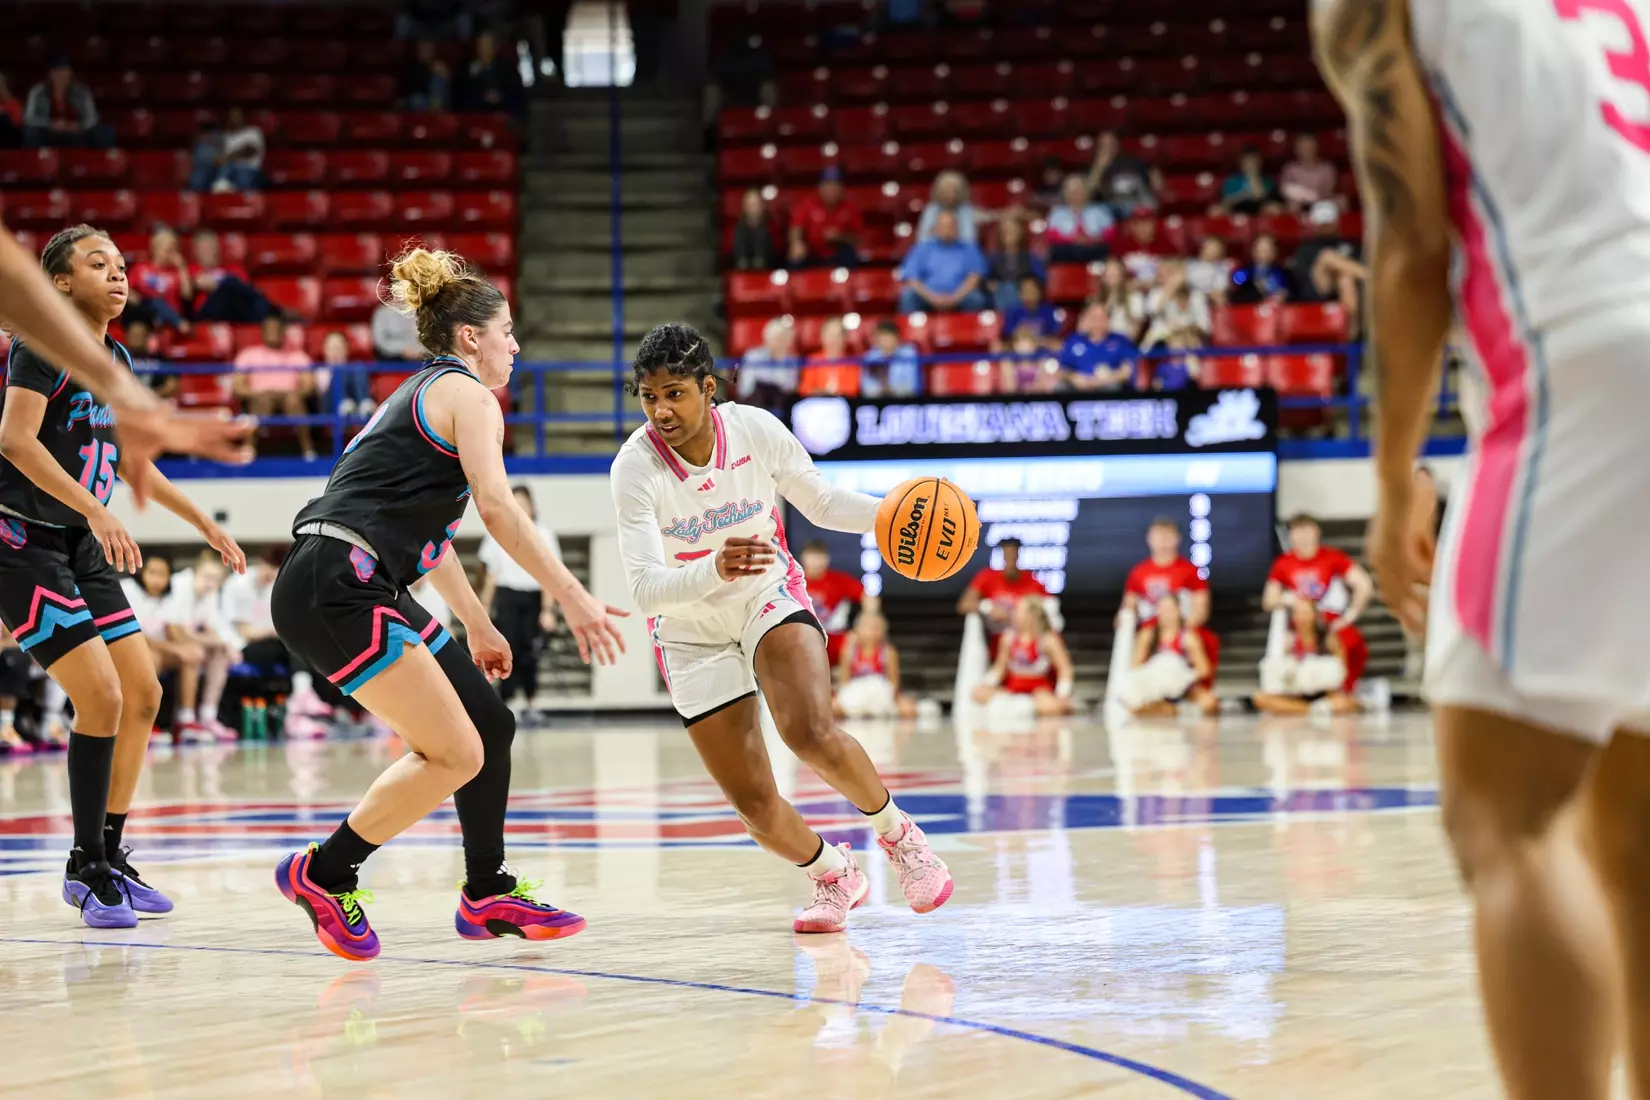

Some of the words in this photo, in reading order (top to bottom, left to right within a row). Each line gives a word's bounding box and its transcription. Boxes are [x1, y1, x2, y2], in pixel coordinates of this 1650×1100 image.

[1553, 0, 1650, 156] 3
[79, 438, 117, 508] 15
[661, 515, 703, 545] Lady
[702, 498, 764, 534] Techsters
[897, 496, 929, 566] Wilson
